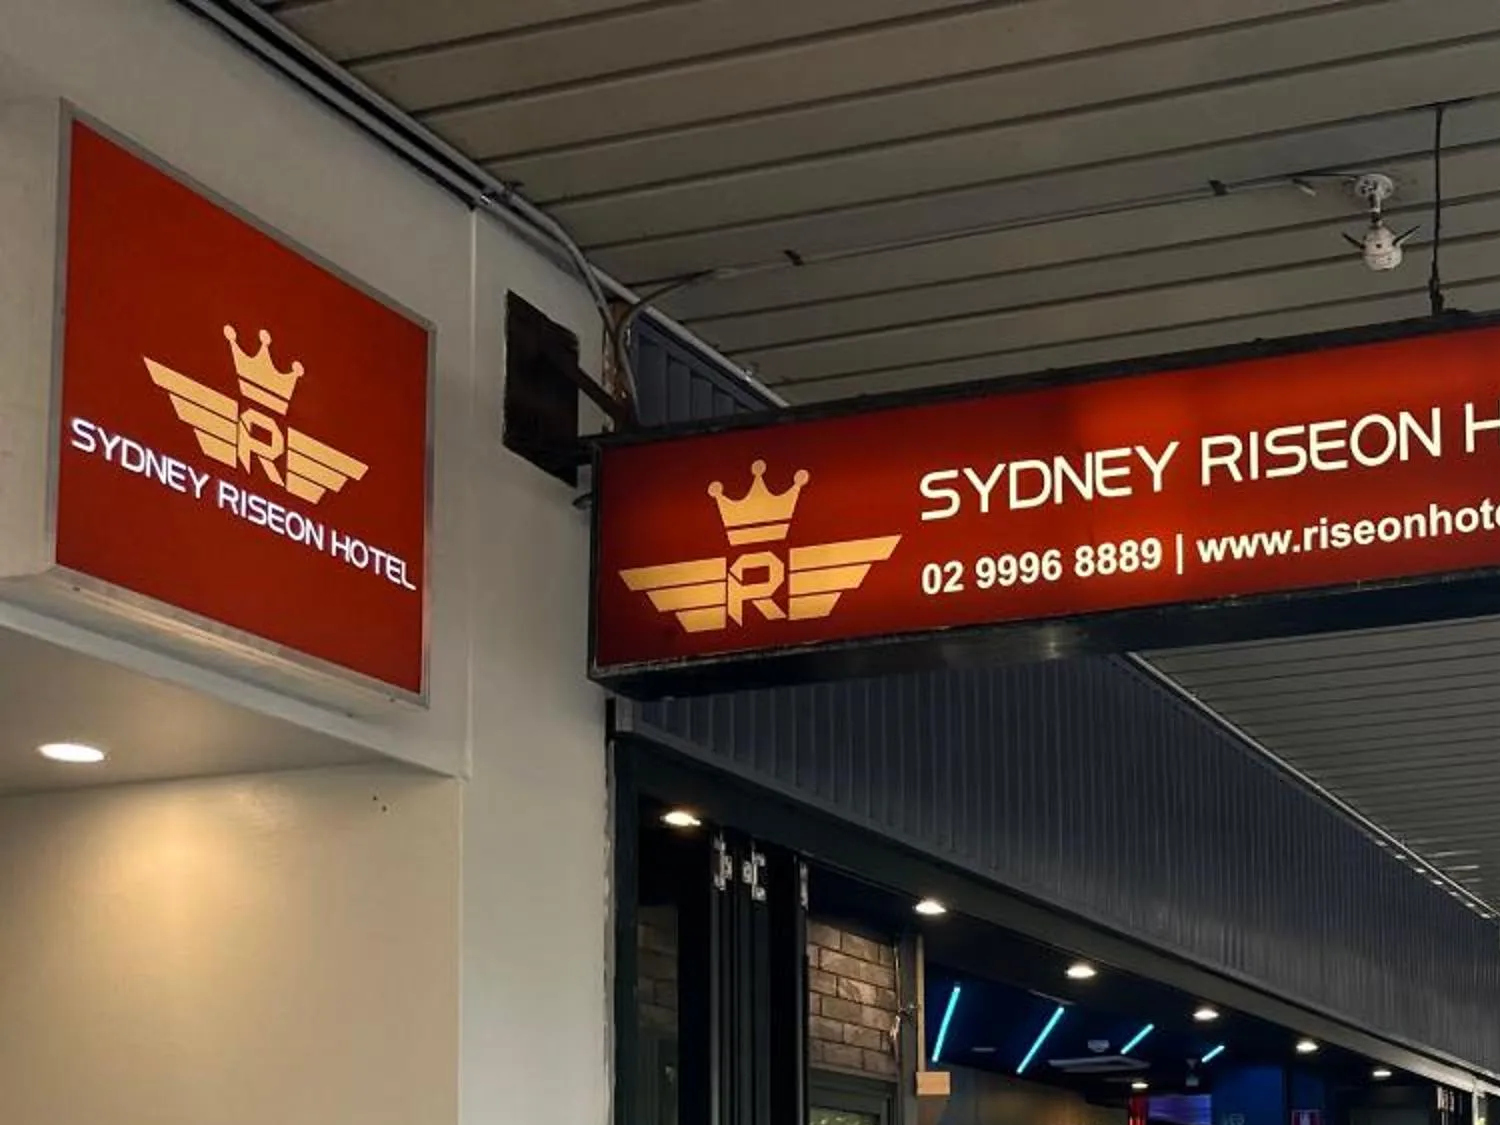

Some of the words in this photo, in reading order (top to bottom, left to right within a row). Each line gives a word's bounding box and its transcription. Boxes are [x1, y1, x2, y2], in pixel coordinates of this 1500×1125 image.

[71, 416, 210, 499] SYDNEY
[218, 481, 325, 552] RISEON
[331, 528, 417, 592] HOTEL
[919, 440, 1180, 522] SYDNEY
[1199, 406, 1442, 486] RISEON
[920, 561, 965, 595] 02
[974, 548, 1064, 591] 9996
[1075, 536, 1163, 578] 8889
